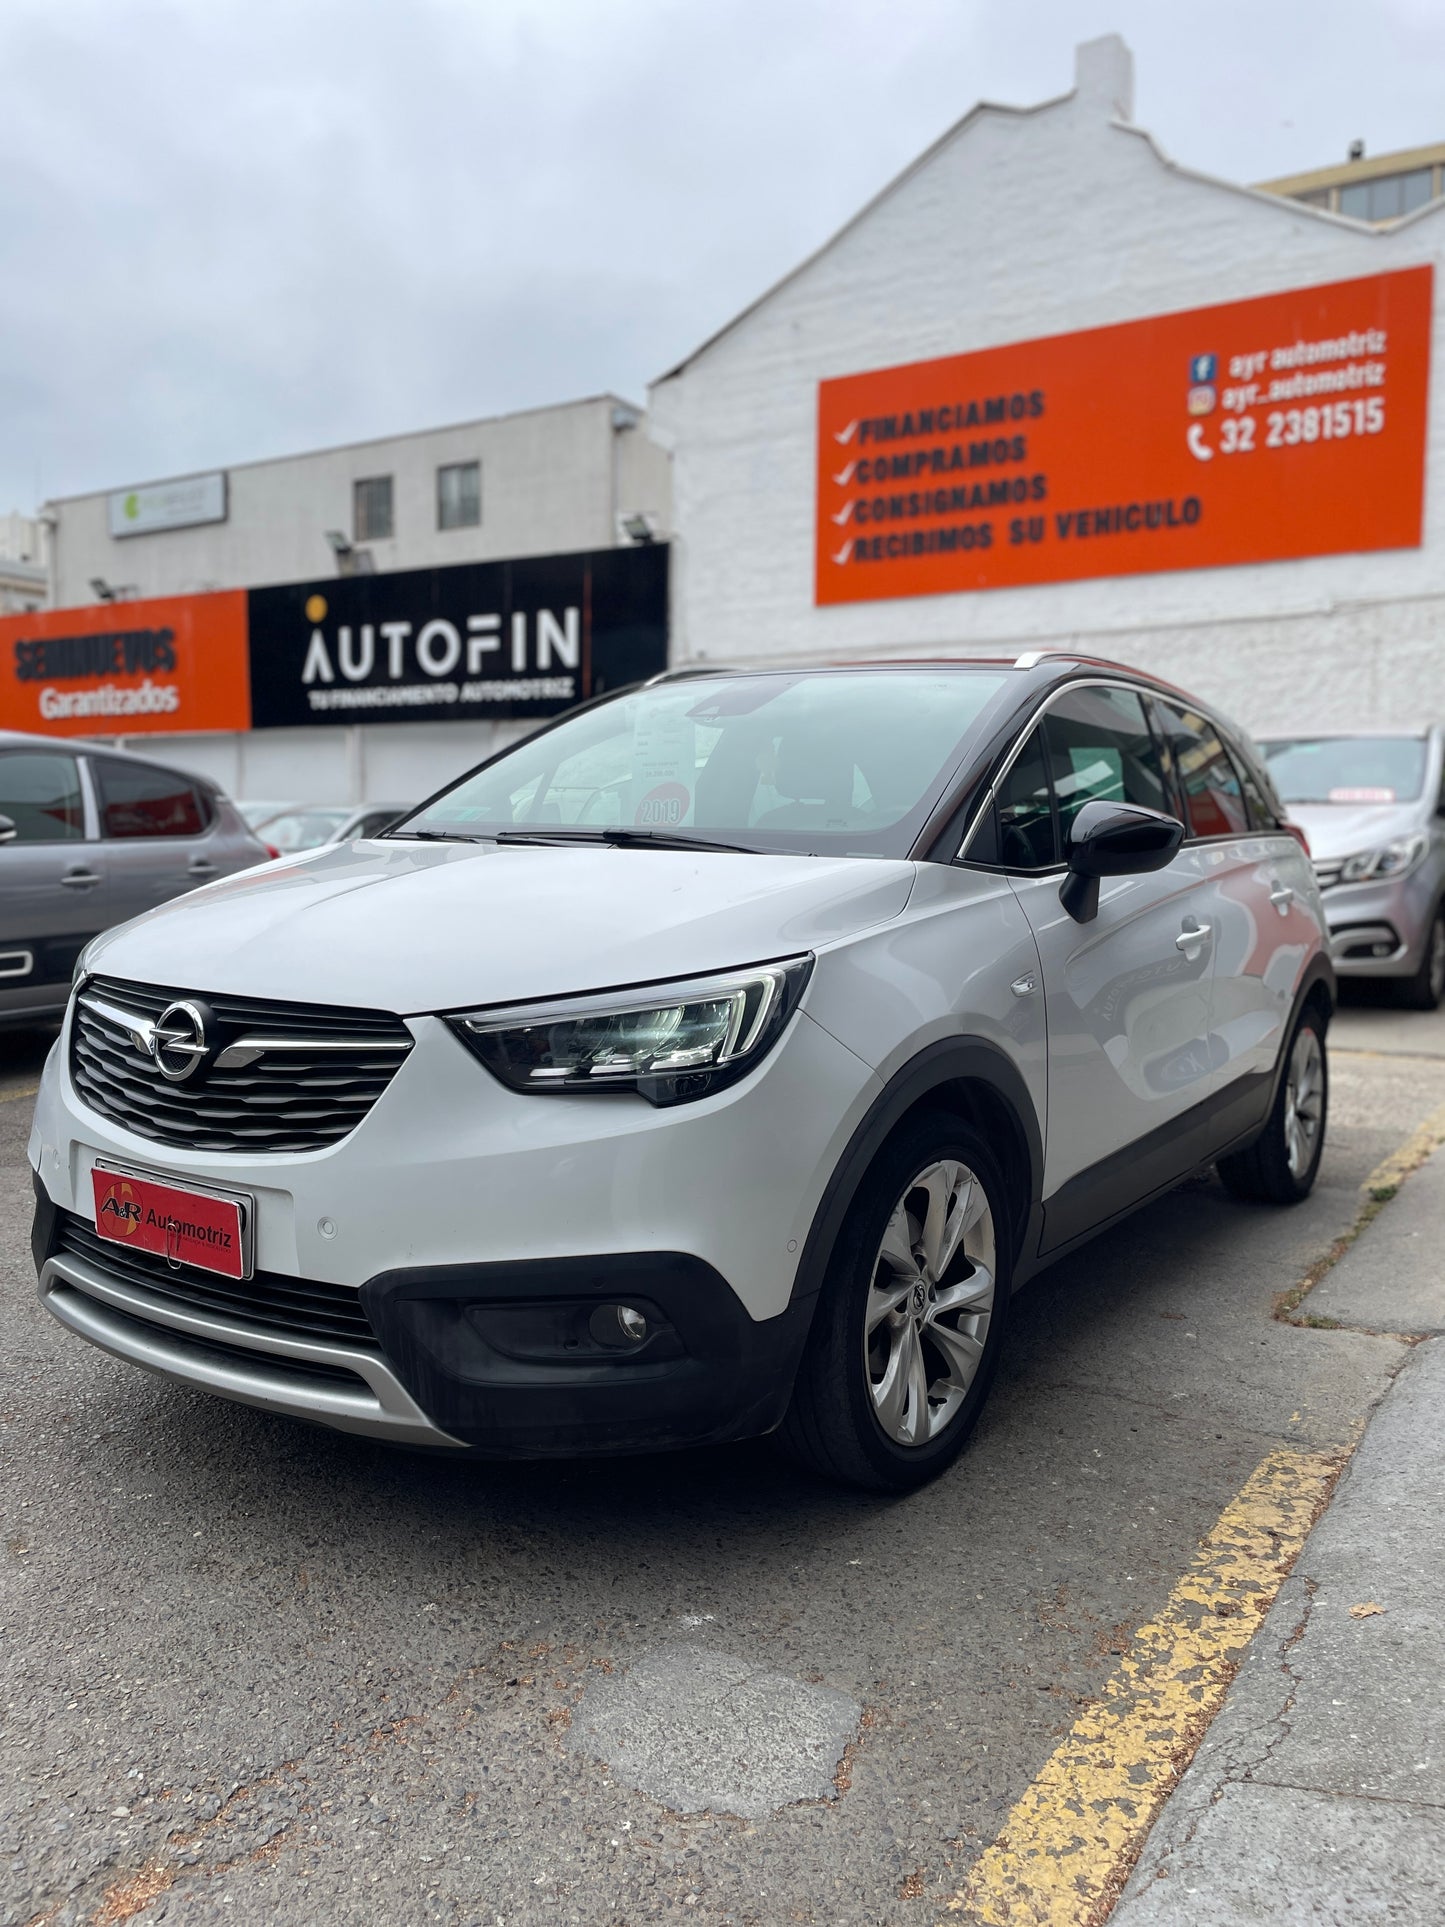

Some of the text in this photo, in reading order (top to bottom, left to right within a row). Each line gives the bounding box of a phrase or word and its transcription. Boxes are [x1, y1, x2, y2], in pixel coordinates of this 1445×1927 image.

[1229, 328, 1386, 381] ayr automotriz
[859, 390, 1044, 445] FINANCIAMOS
[1220, 396, 1385, 454] 32 2381515
[856, 435, 1026, 484] COMPRAMOS
[854, 474, 1046, 524] CONSIGNAMOS
[854, 495, 1202, 562] RECIBIMOS SU VEHICULO
[301, 606, 580, 684] AUTOFIN
[39, 678, 180, 720] Garantizados
[641, 798, 682, 823] 2019
[101, 1197, 142, 1223] A&R
[146, 1208, 232, 1248] Automotriz
